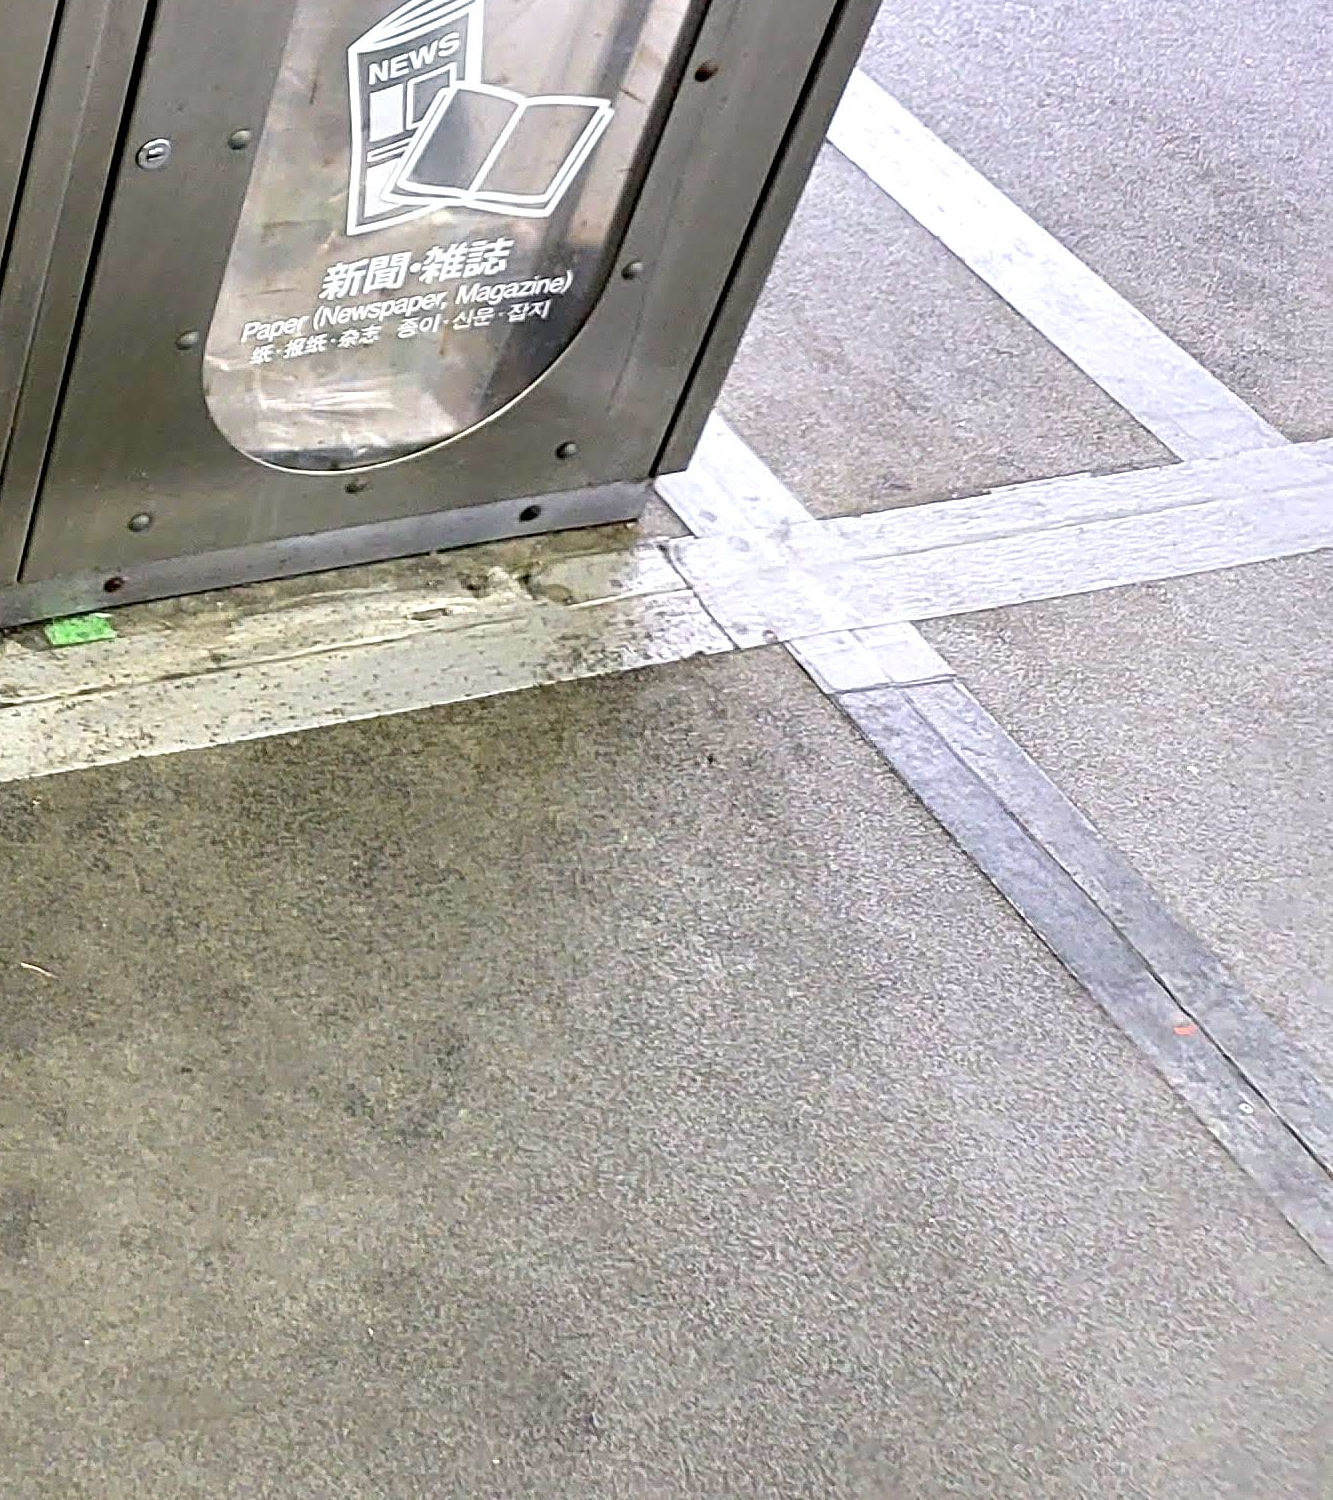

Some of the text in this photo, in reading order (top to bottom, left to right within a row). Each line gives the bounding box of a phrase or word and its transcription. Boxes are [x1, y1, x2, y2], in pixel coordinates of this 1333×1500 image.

[368, 31, 460, 85] NEWS
[319, 237, 514, 301] 新聞・雑誌
[240, 269, 574, 343] Paper (Newspaper, Magazine)
